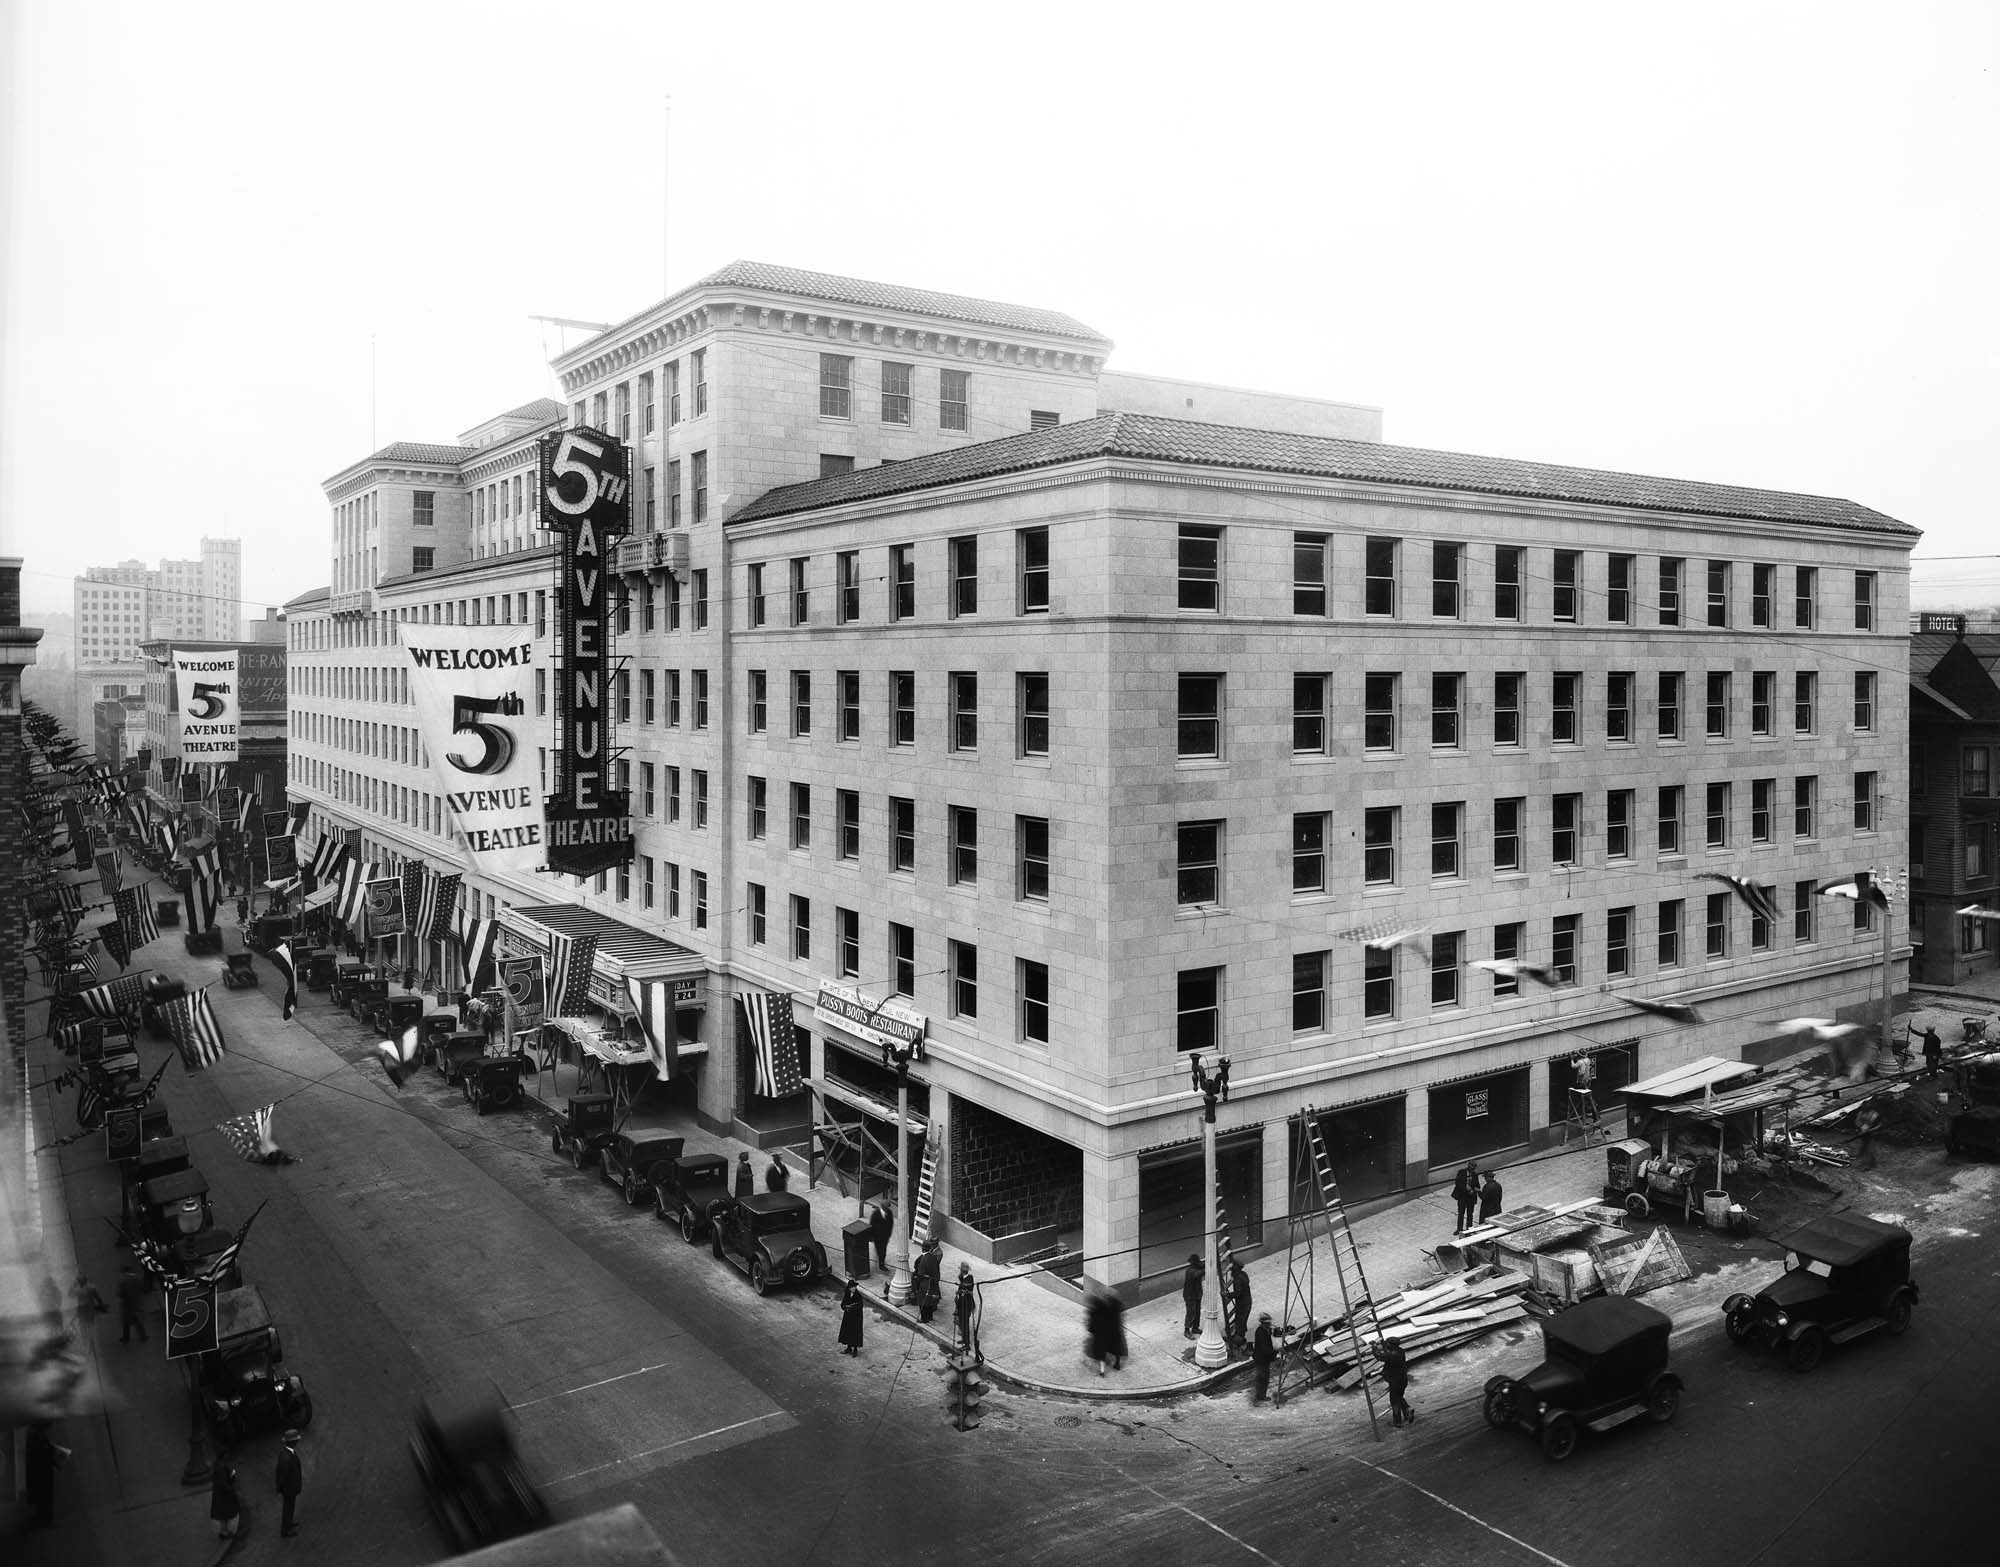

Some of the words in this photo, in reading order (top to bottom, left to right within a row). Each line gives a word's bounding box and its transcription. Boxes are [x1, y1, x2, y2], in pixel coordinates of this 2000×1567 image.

[1928, 616, 1958, 631] HOTEL
[408, 643, 532, 670] WELCOME
[575, 518, 599, 810] AVENUE
[177, 661, 235, 672] WELCOME
[184, 724, 237, 736] AVENUE
[183, 741, 237, 753] THEATRE
[465, 824, 541, 852] EATRE
[545, 816, 630, 847] THEATRE
[674, 981, 691, 990] IDAY
[682, 991, 691, 1000] 24
[846, 1005, 868, 1024] BOOTS
[870, 1015, 919, 1040] RESTAURANT
[1467, 1092, 1487, 1105] GLASS
[170, 1286, 211, 1339] 5
